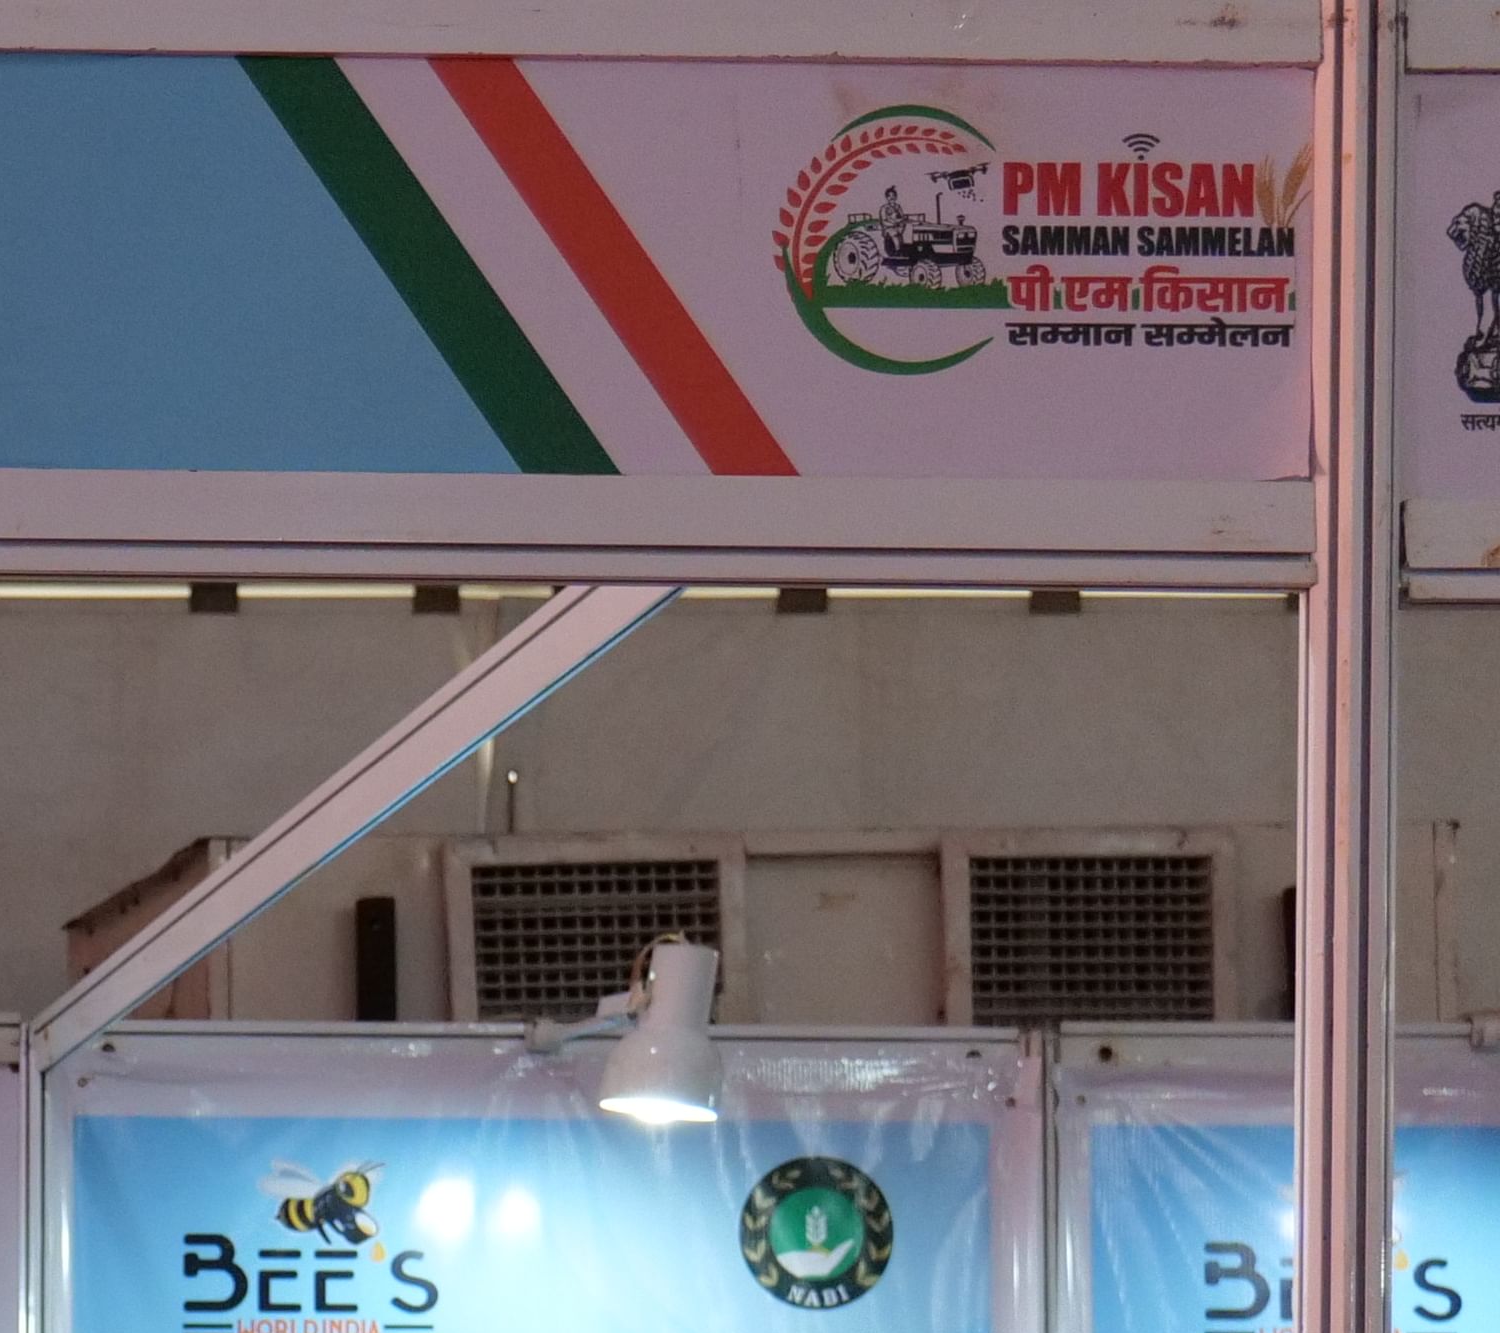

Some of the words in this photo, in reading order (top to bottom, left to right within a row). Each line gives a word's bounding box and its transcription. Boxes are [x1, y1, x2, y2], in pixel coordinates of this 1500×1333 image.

[1004, 162, 1081, 216] PM
[1097, 163, 1255, 218] KISAN
[1002, 225, 1129, 256] SAMMAN
[1138, 226, 1294, 256] SAMMELAN
[1007, 265, 1053, 312] पी
[1062, 276, 1133, 312] एम
[1139, 265, 1289, 313] किसान
[1006, 322, 1136, 348] सम्मान
[1142, 316, 1293, 348] सम्मेलन
